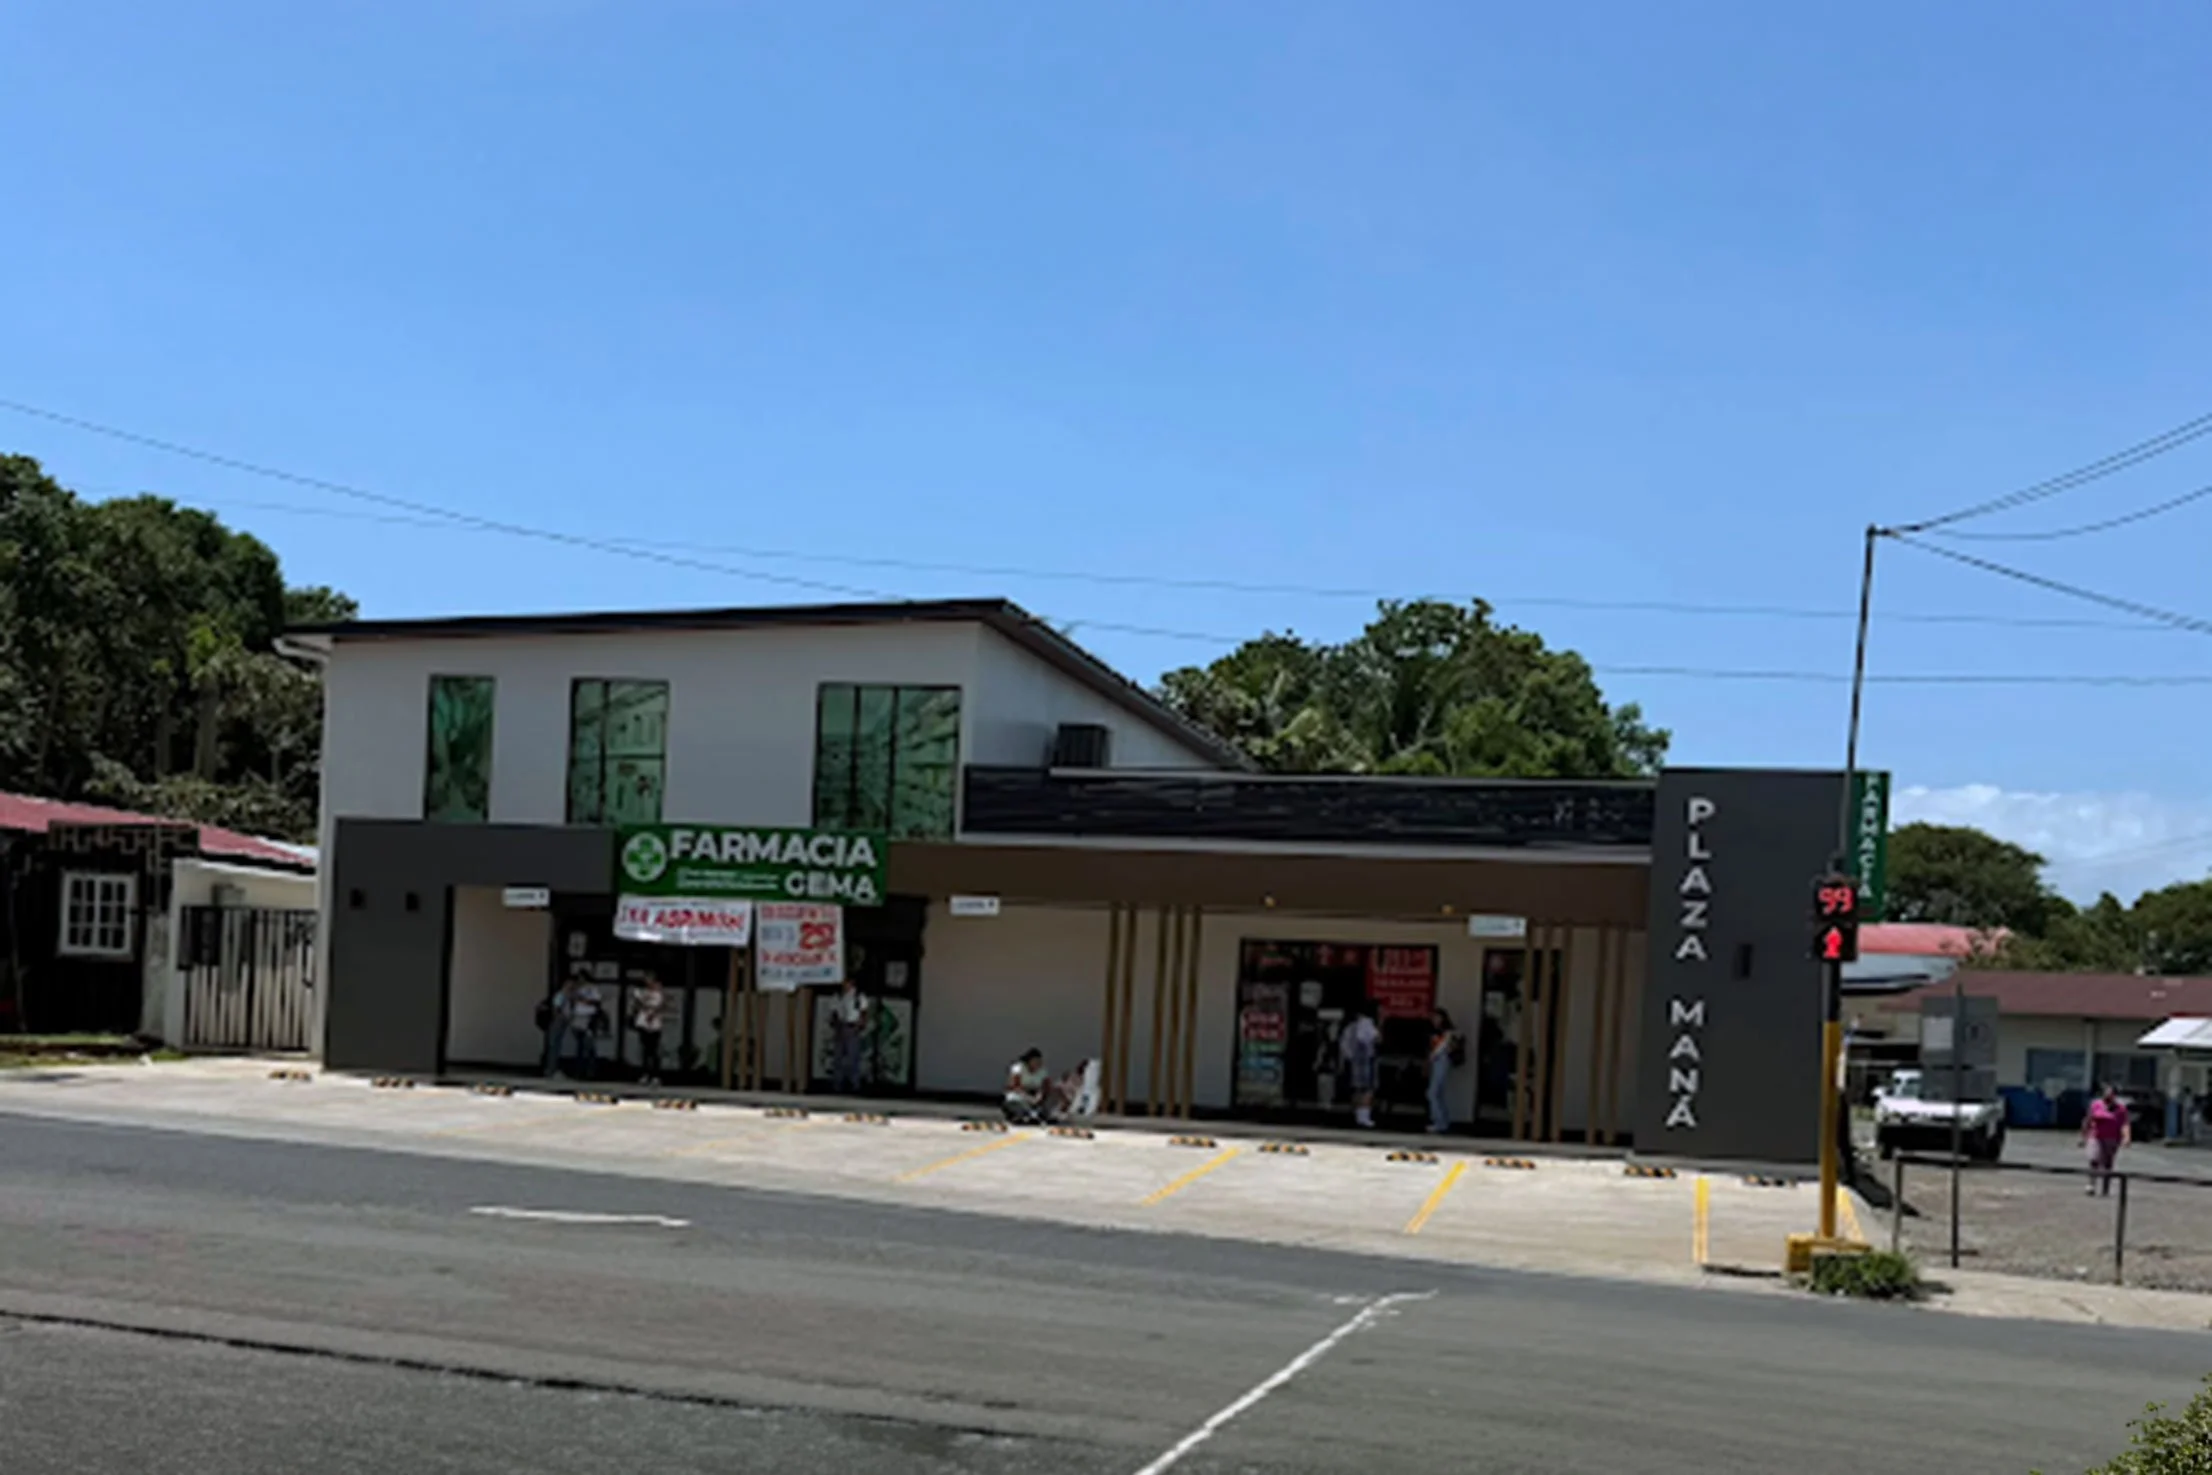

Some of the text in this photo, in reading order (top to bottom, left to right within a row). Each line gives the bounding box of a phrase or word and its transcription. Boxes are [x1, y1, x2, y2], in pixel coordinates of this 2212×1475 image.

[671, 830, 877, 867] FARMACIA
[1677, 798, 1716, 960] PLAZA
[1857, 776, 1881, 897] FARMACIA
